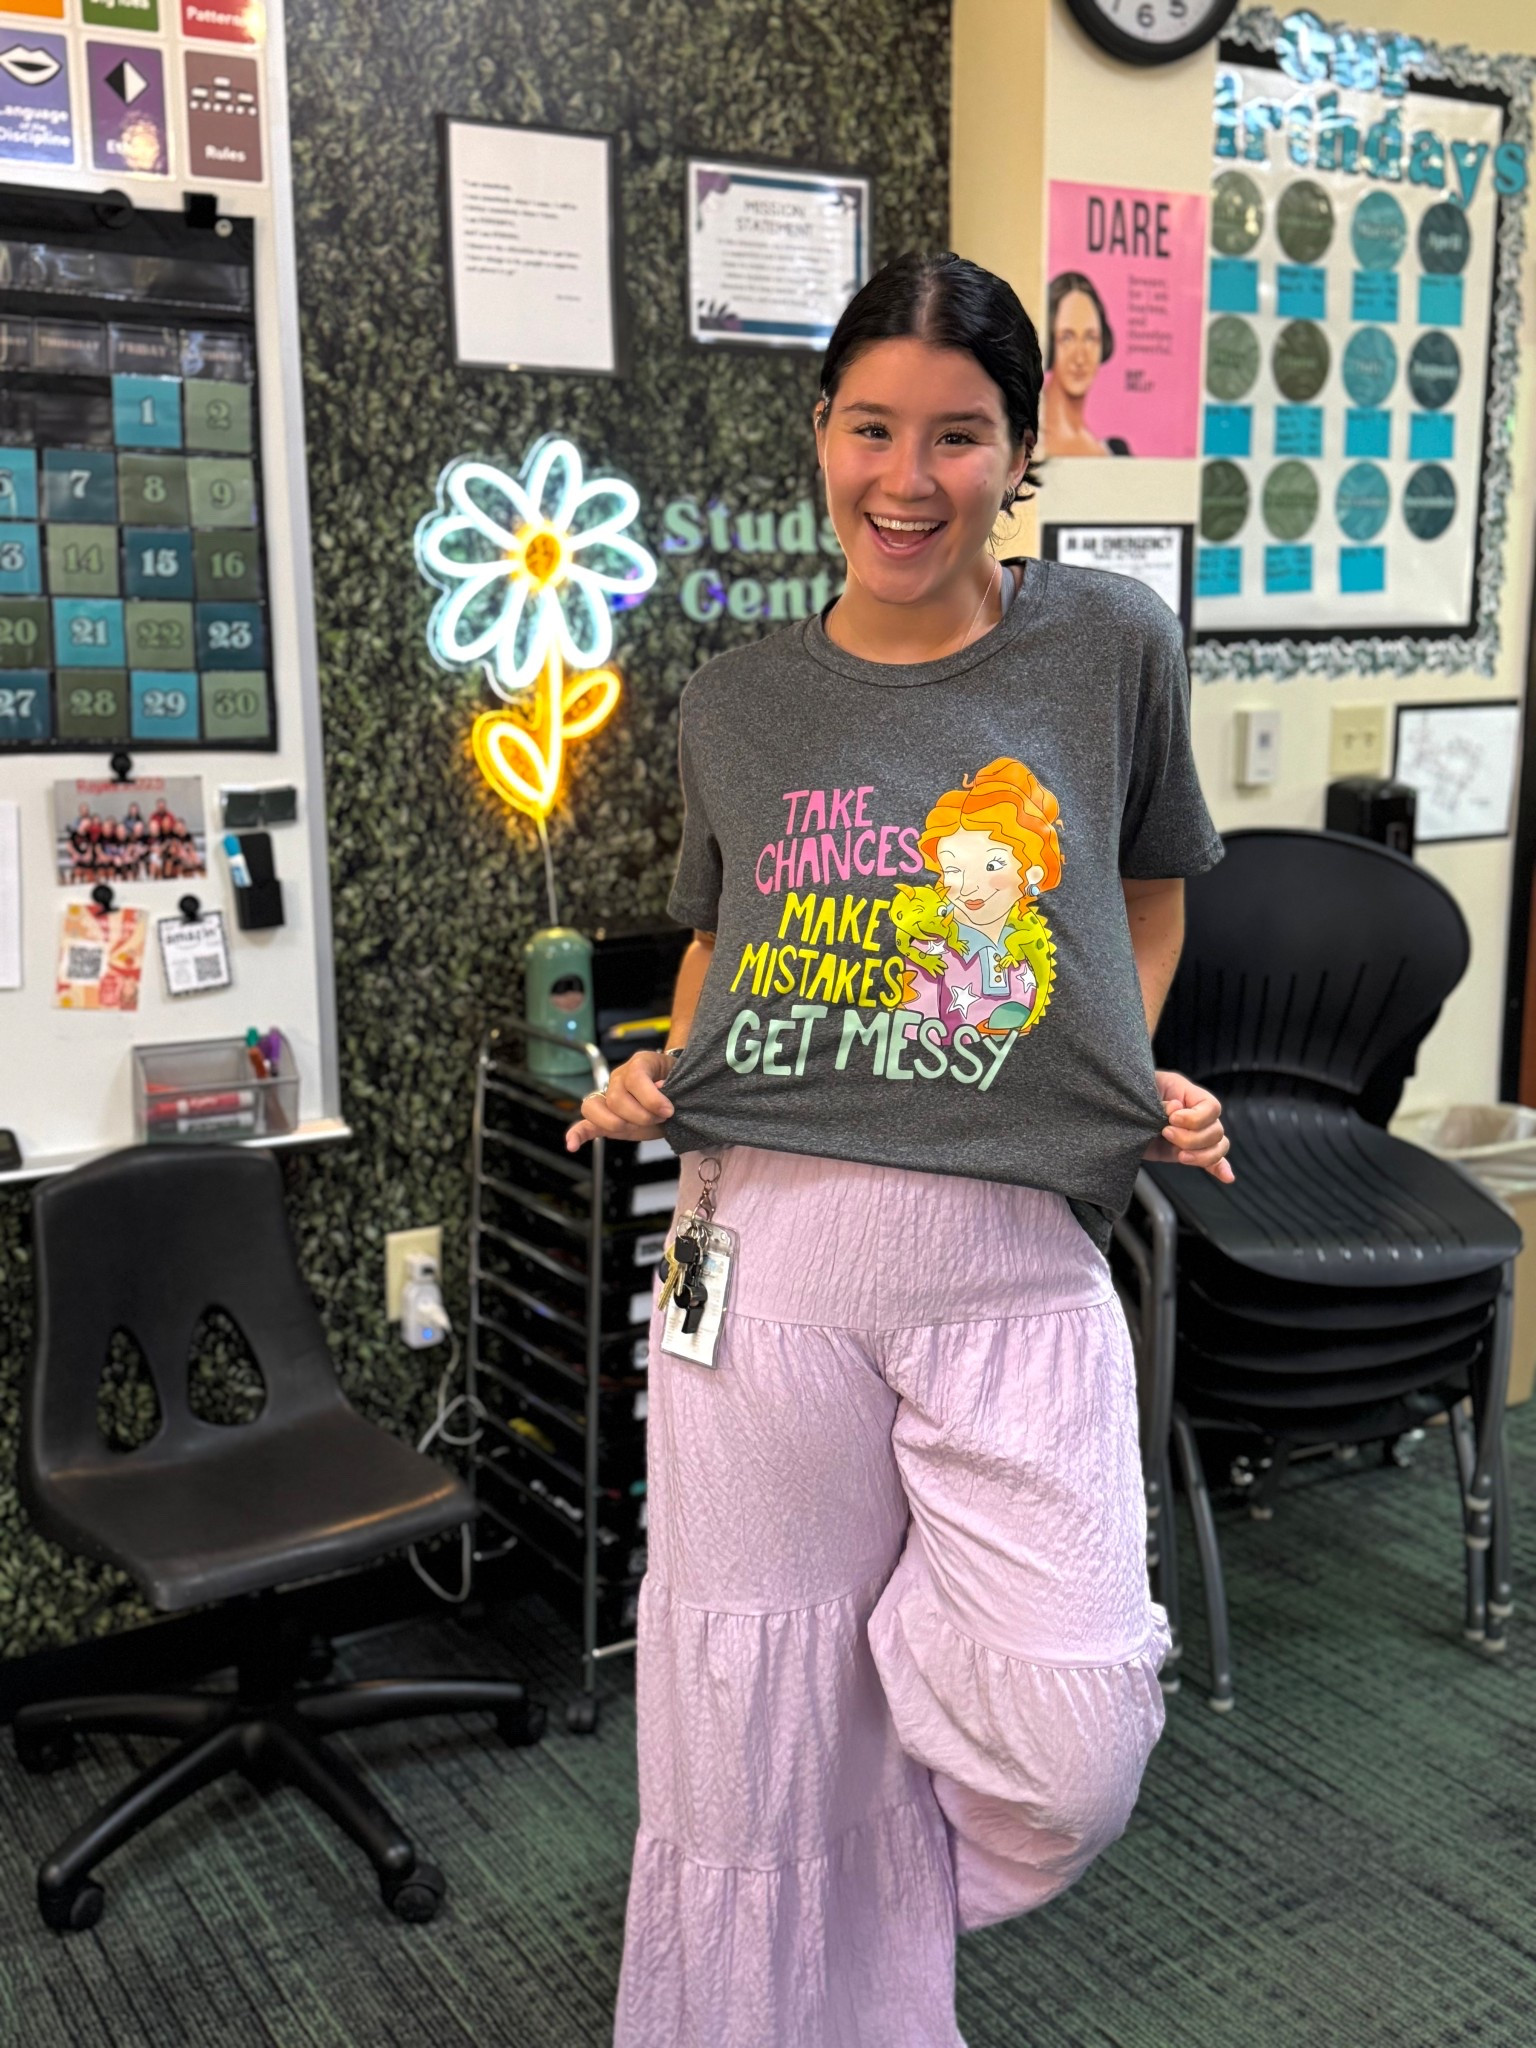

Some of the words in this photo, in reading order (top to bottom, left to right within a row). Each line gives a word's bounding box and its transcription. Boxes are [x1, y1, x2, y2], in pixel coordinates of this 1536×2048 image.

[1136, 3, 1155, 28] 6
[205, 145, 247, 162] Rules
[1087, 196, 1171, 259] DARE
[140, 397, 155, 426] 1
[207, 400, 231, 429] 2
[70, 470, 91, 498] 7
[143, 475, 166, 502] 8
[210, 480, 233, 507] 9
[64, 543, 103, 574] 14
[141, 549, 179, 577] 15
[211, 552, 245, 579] 16
[681, 568, 846, 623] Cent
[0, 617, 38, 645] 20
[70, 618, 108, 645] 21
[137, 620, 184, 648] 22
[207, 620, 253, 649] 23
[0, 688, 36, 717] 27
[70, 688, 117, 717] 28
[143, 690, 187, 718] 29
[213, 690, 259, 719] 30
[783, 786, 874, 835] TAKE
[754, 826, 925, 895] CHANCES
[777, 892, 891, 951] MAKE
[729, 941, 905, 1009] MISTAKES
[725, 1004, 828, 1076] GET
[834, 1010, 1020, 1092] MESSY
